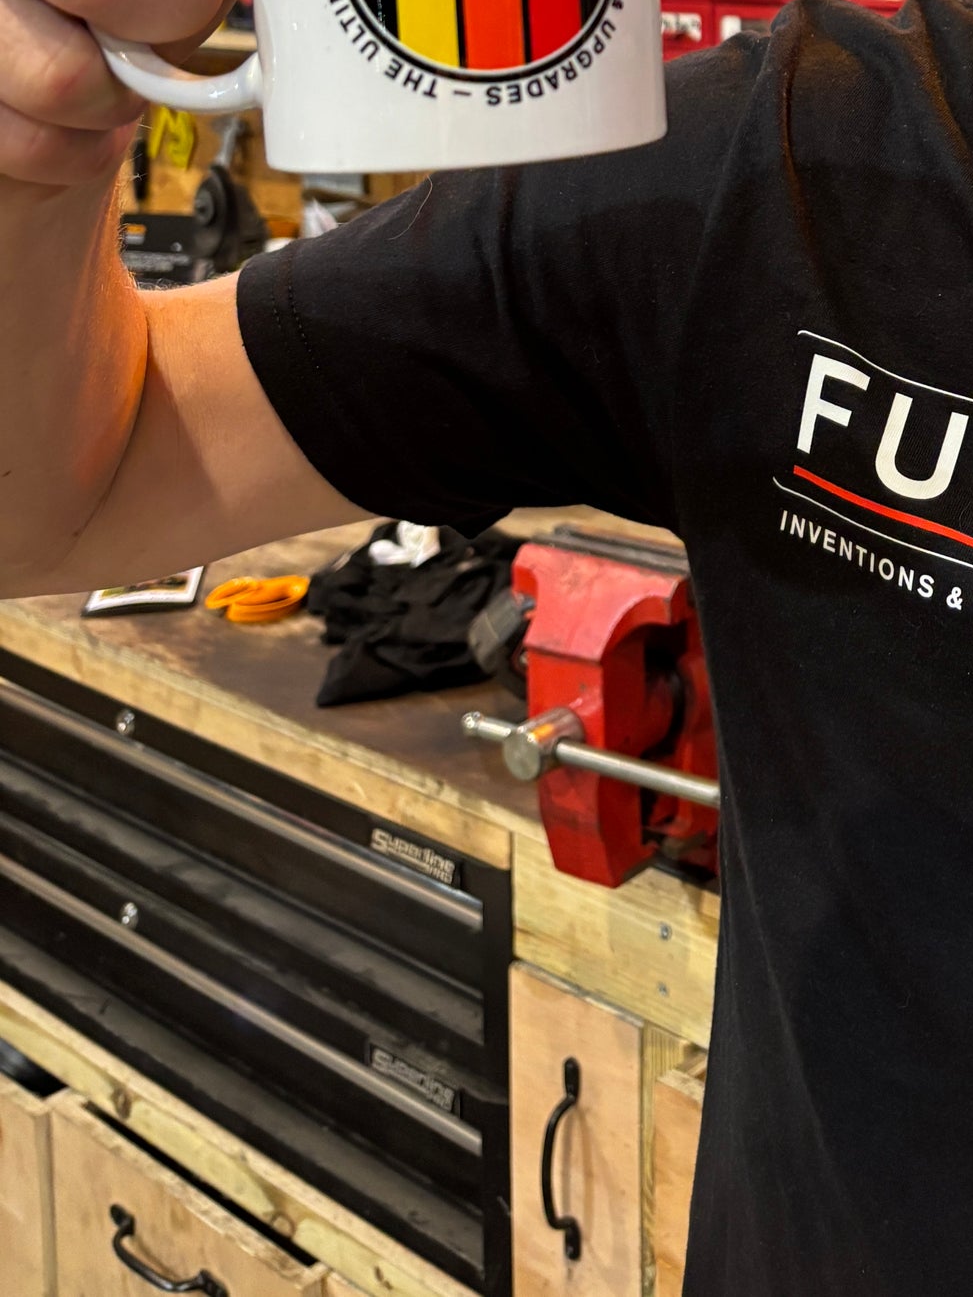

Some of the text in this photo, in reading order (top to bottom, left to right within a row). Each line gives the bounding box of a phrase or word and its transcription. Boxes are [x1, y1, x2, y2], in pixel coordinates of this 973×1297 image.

[384, 58, 438, 99] THE
[485, 19, 616, 106] UPGRADES
[780, 510, 935, 599] INVENTIONS
[945, 586, 963, 611] &
